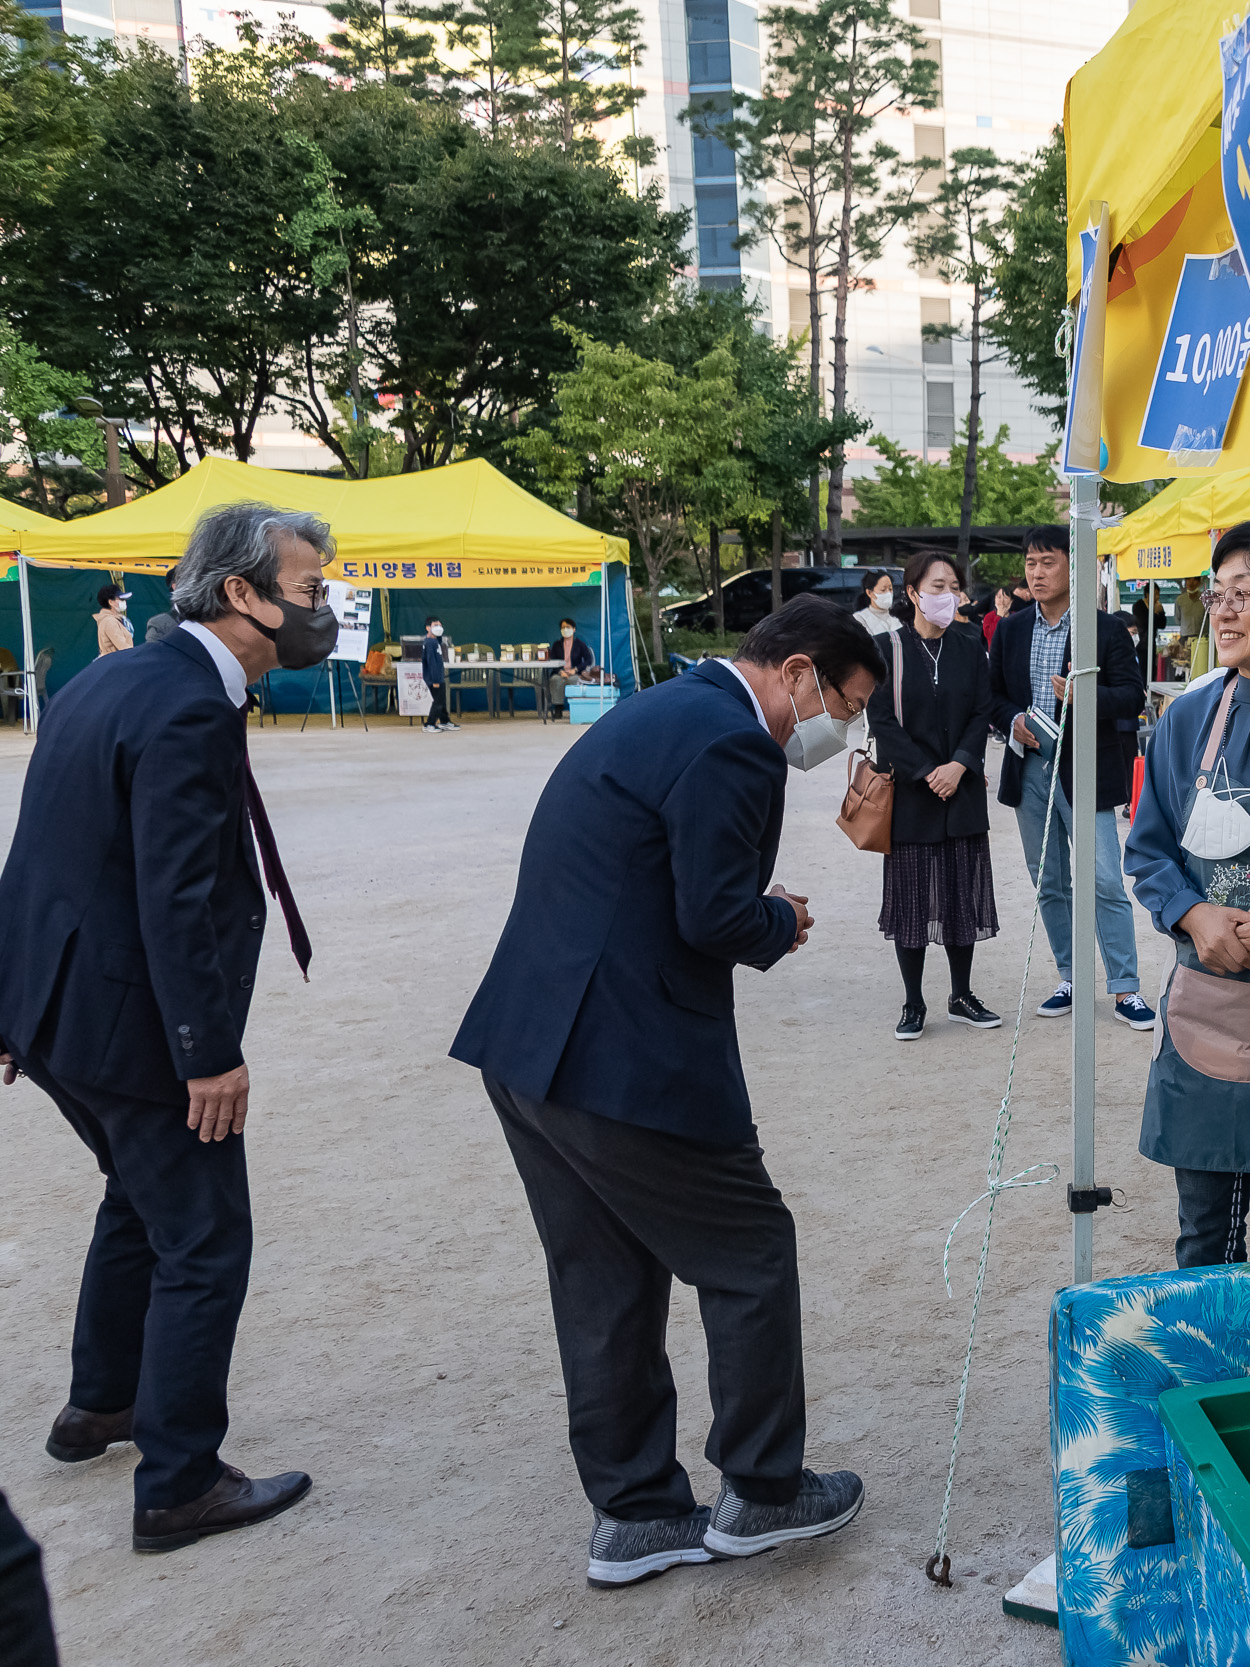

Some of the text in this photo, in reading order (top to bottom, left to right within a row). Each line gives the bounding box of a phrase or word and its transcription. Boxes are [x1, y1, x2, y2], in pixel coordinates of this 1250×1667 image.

[1162, 546, 1172, 567] 체험
[343, 562, 417, 579] 도시양봉
[426, 562, 462, 579] 체험
